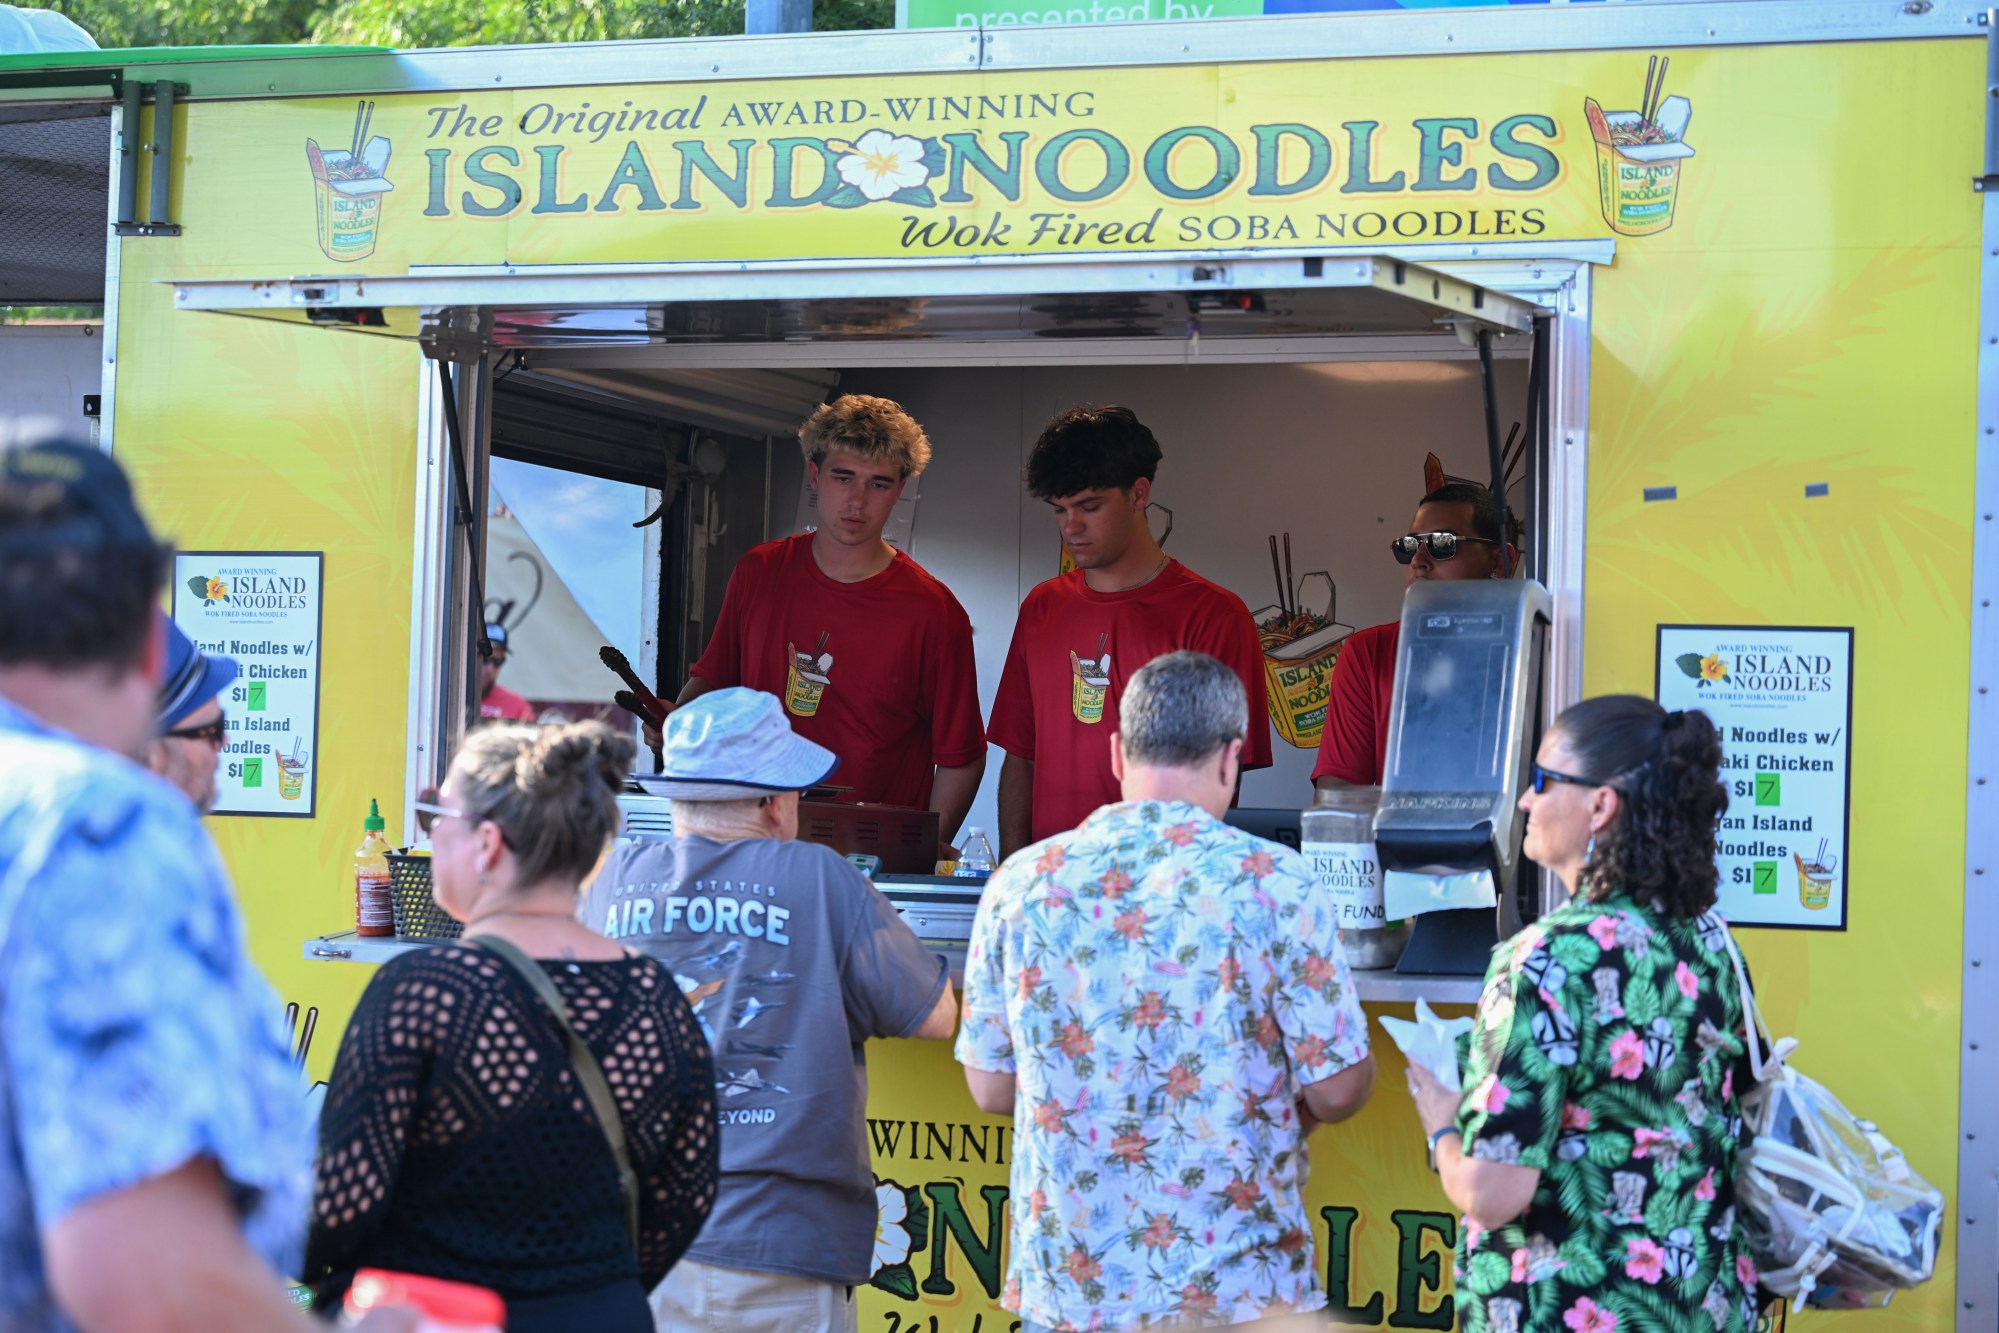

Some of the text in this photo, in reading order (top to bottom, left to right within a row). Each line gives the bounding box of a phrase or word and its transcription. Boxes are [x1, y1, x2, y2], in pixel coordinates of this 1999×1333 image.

[427, 92, 1095, 144] The Original AWARD-WINNING
[423, 137, 840, 217] ISLAND
[940, 114, 1561, 203] NOODLES
[1620, 165, 1674, 180] ISLAND
[1620, 186, 1672, 201] NOODLES
[333, 200, 377, 212] ISLAND
[900, 207, 1547, 249] Wok Fired SOBA NOODLES
[217, 568, 277, 576] AWARD WINNING
[232, 577, 306, 594] ISLAND
[232, 595, 307, 609] NOODLES
[194, 640, 313, 657] land Noodles w/
[1715, 644, 1792, 653] AWARD WINNING
[249, 664, 307, 679] Chicken
[1279, 653, 1338, 688] ISLAND
[1735, 654, 1832, 675] ISLAND
[1734, 675, 1832, 692] NOODLES
[1699, 692, 1717, 700] WOK
[1746, 693, 1766, 701] SOBA
[1769, 693, 1807, 701] NOODLES
[245, 717, 290, 731] Island
[1731, 726, 1808, 744] Noodles
[1815, 728, 1841, 746] w/
[222, 740, 271, 754] oodles
[1756, 754, 1834, 772] Chicken
[1389, 796, 1492, 809] NAPKINS
[1752, 814, 1813, 832] Island
[1313, 857, 1375, 875] ISLAND
[615, 879, 777, 897] UNITED STATES
[1344, 904, 1386, 919] FUND
[603, 896, 790, 946] AIR FORCE
[718, 1109, 776, 1124] EYOND
[866, 1119, 1016, 1165] WINNI
